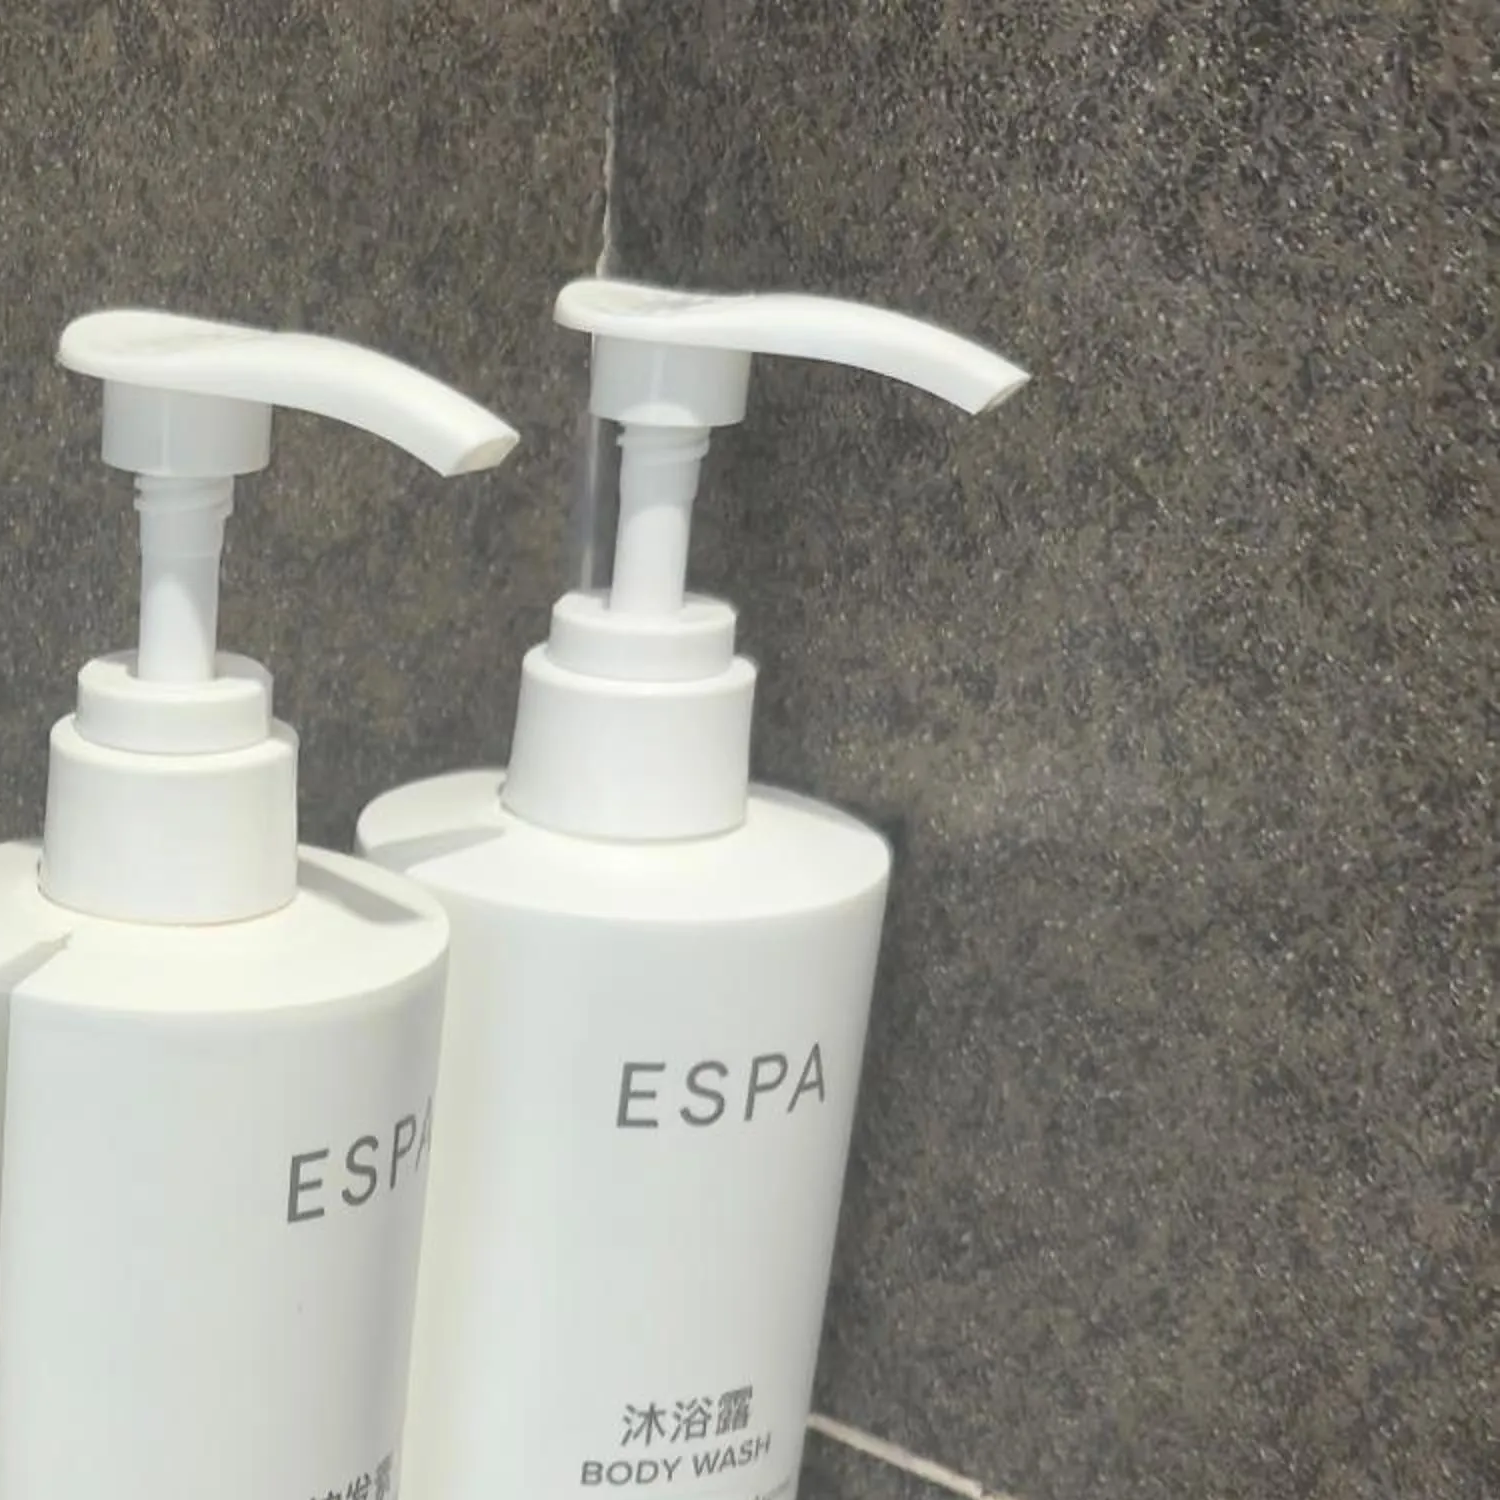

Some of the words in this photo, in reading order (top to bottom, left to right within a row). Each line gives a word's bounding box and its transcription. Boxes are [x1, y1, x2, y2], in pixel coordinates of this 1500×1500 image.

[616, 1041, 825, 1128] ESPA
[620, 1384, 753, 1447] 沐浴露
[581, 1455, 682, 1487] BODY
[692, 1431, 772, 1478] WASH
